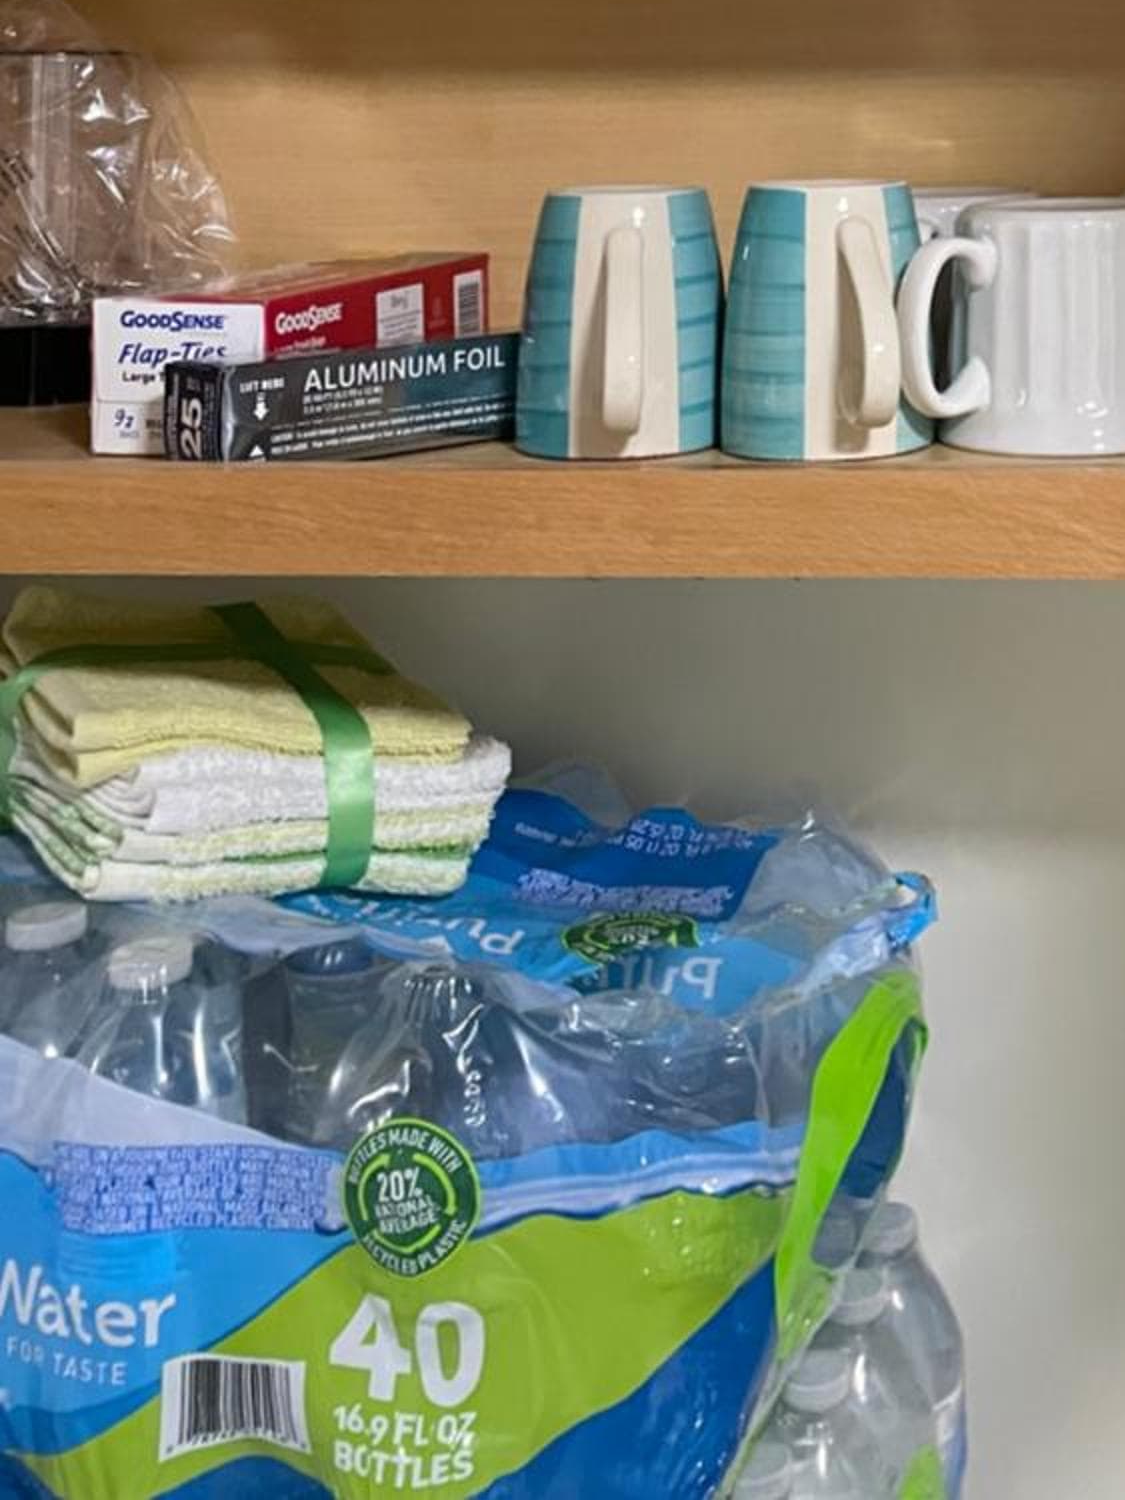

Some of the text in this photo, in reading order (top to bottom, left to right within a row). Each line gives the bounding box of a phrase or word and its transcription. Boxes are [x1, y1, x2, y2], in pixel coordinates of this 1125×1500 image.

[122, 371, 156, 385] Large
[304, 345, 506, 393] ALUMINUM FOIL
[180, 398, 202, 460] 25
[389, 1127, 428, 1149] MADE
[428, 1137, 463, 1173] WITH
[376, 1166, 424, 1202] 20%
[417, 1219, 467, 1270] PLASTIC
[0, 1259, 177, 1348] Water
[6, 1336, 128, 1386] FOR TASTE
[329, 1292, 486, 1408] 40
[333, 1403, 389, 1446] 16.9
[392, 1411, 429, 1447] FL
[436, 1411, 478, 1448] OZ
[335, 1439, 475, 1489] BOTTLES
